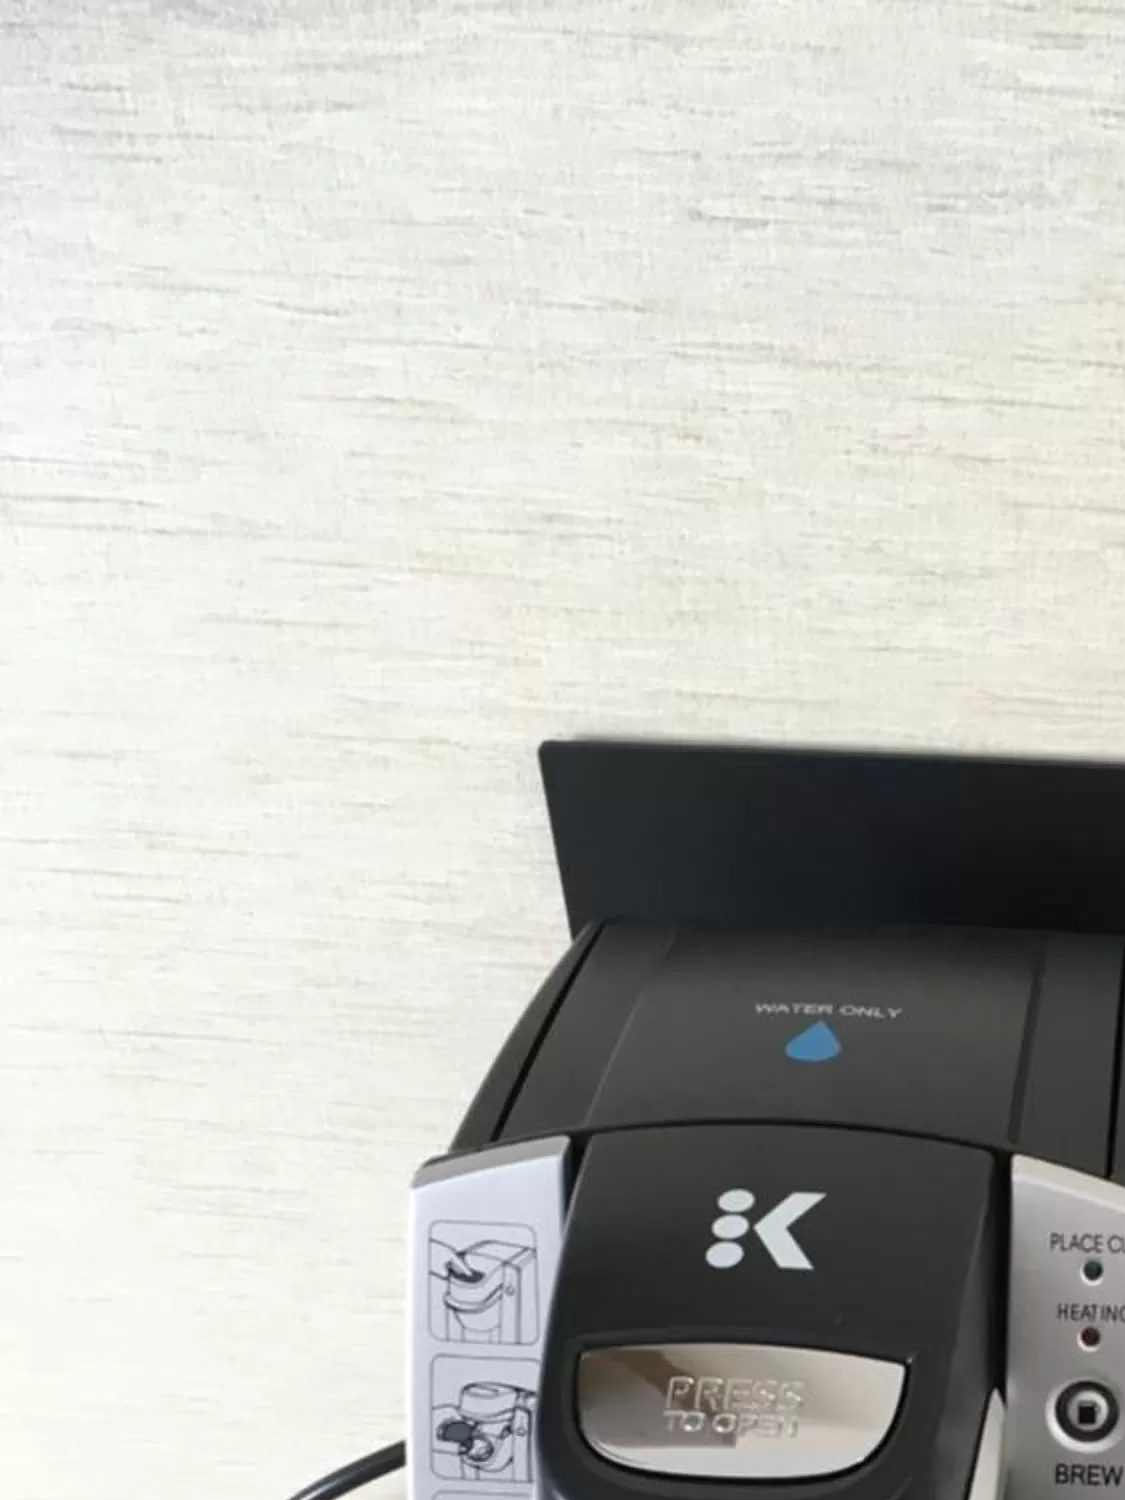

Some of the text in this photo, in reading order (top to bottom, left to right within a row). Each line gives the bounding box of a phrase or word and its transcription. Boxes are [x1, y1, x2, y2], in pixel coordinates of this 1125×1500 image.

[754, 1002, 904, 1019] WATER ONLY
[1049, 1231, 1104, 1254] PLACE
[665, 1376, 805, 1412] PRESS
[663, 1409, 800, 1439] TO OPEN
[1054, 1462, 1125, 1487] BREW
